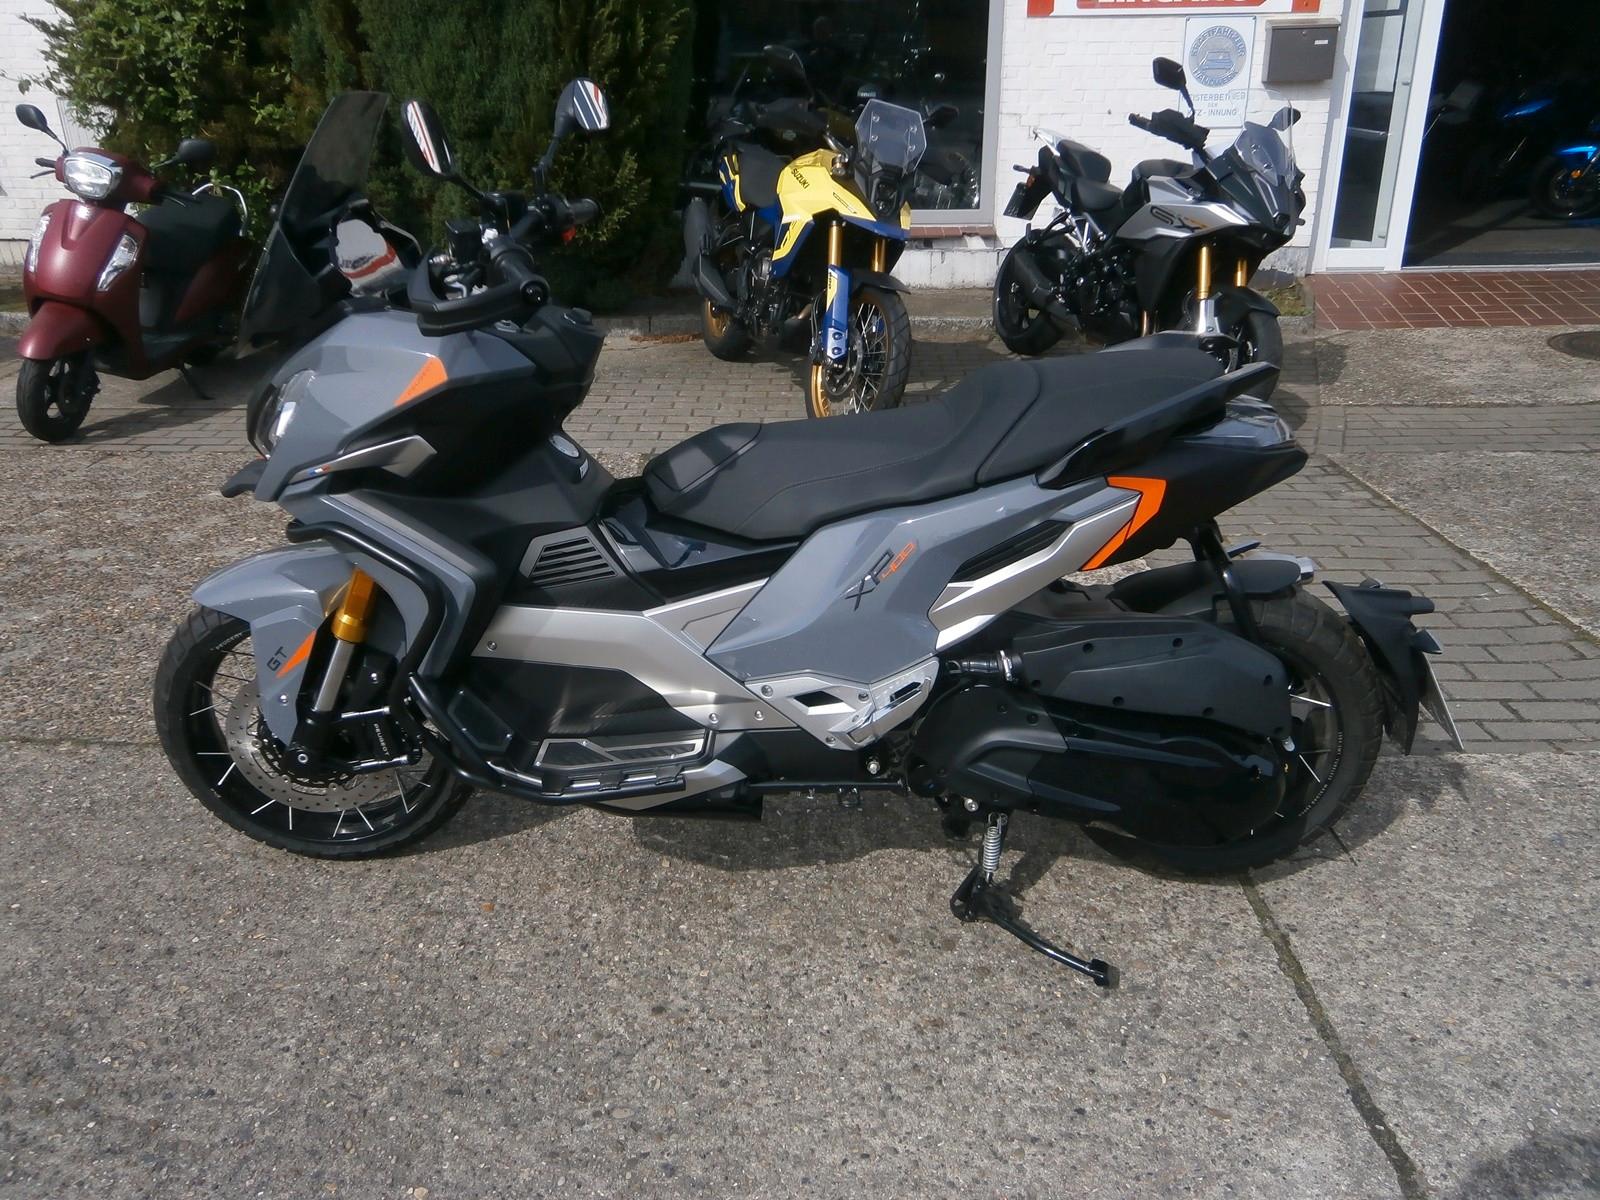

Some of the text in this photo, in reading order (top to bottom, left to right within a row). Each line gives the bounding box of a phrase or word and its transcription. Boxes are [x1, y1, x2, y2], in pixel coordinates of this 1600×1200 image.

[791, 168, 811, 189] SUZUKI
[266, 645, 288, 672] GT
[373, 723, 390, 756] PEUGEOT
